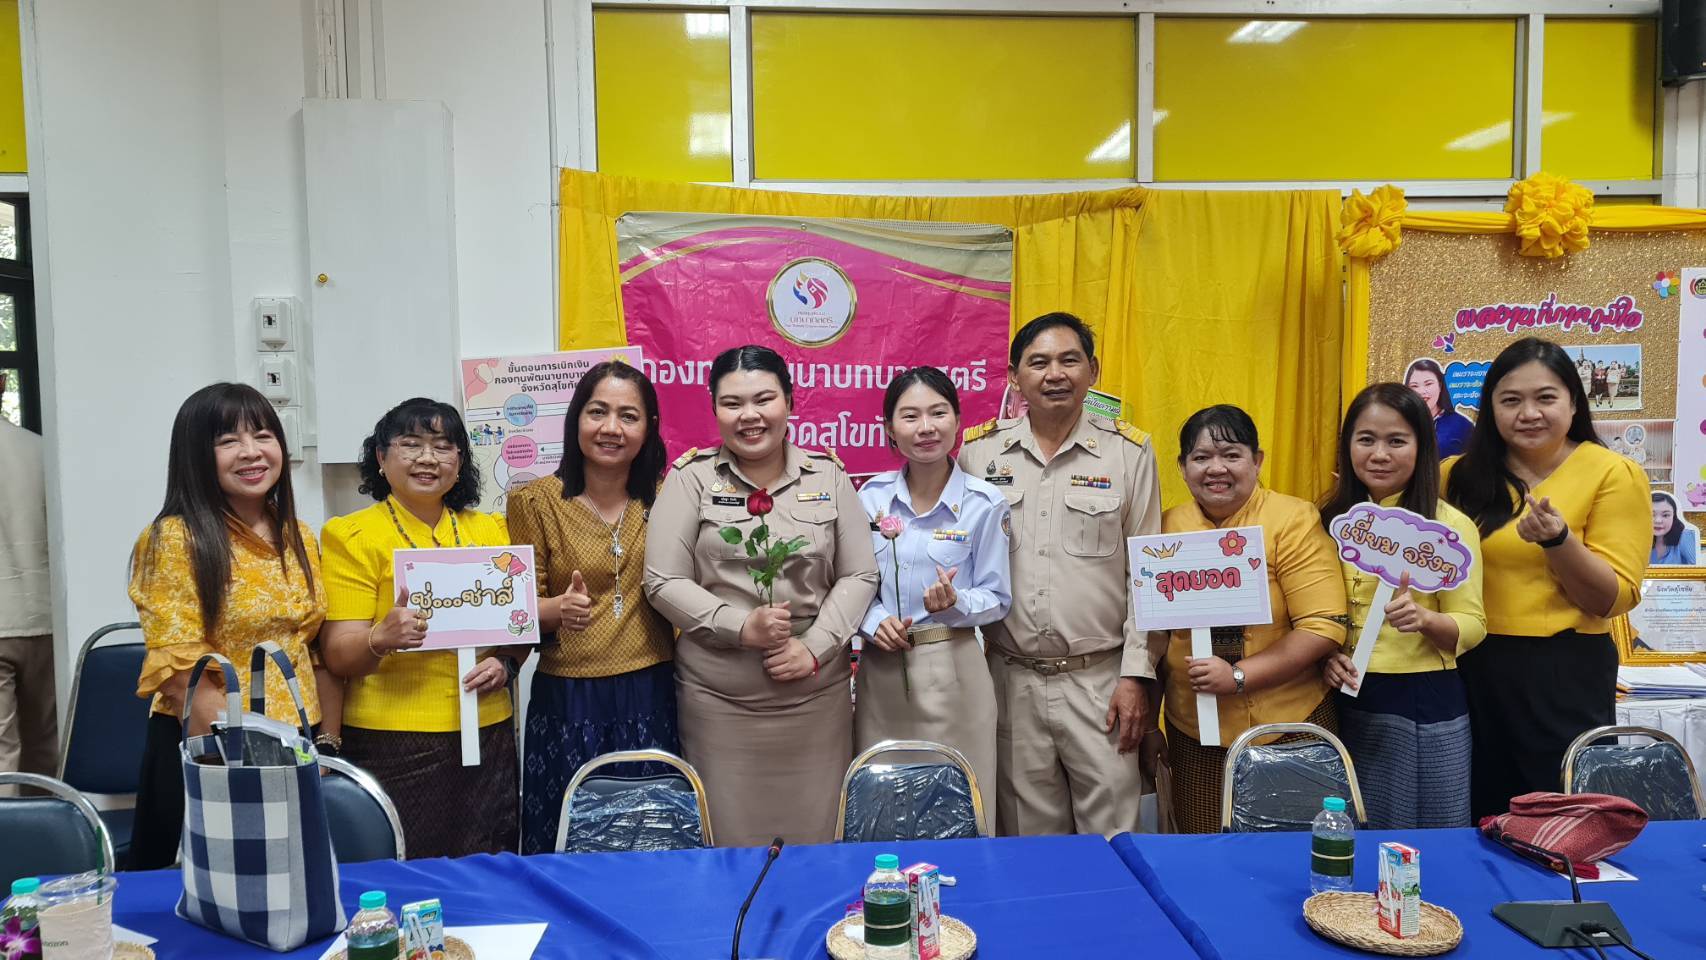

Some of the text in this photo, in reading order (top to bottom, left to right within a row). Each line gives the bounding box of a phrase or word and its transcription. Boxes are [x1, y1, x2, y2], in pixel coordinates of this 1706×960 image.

[494, 371, 586, 386] กองทุนพัฒนาบทบาท
[507, 359, 590, 374] ขั้นตอนการเบิกเงิน
[787, 411, 886, 449] วัดสุโขทั
[1340, 512, 1458, 583] เยี่ยม จริงๆ
[1156, 566, 1242, 602] สุดยอด
